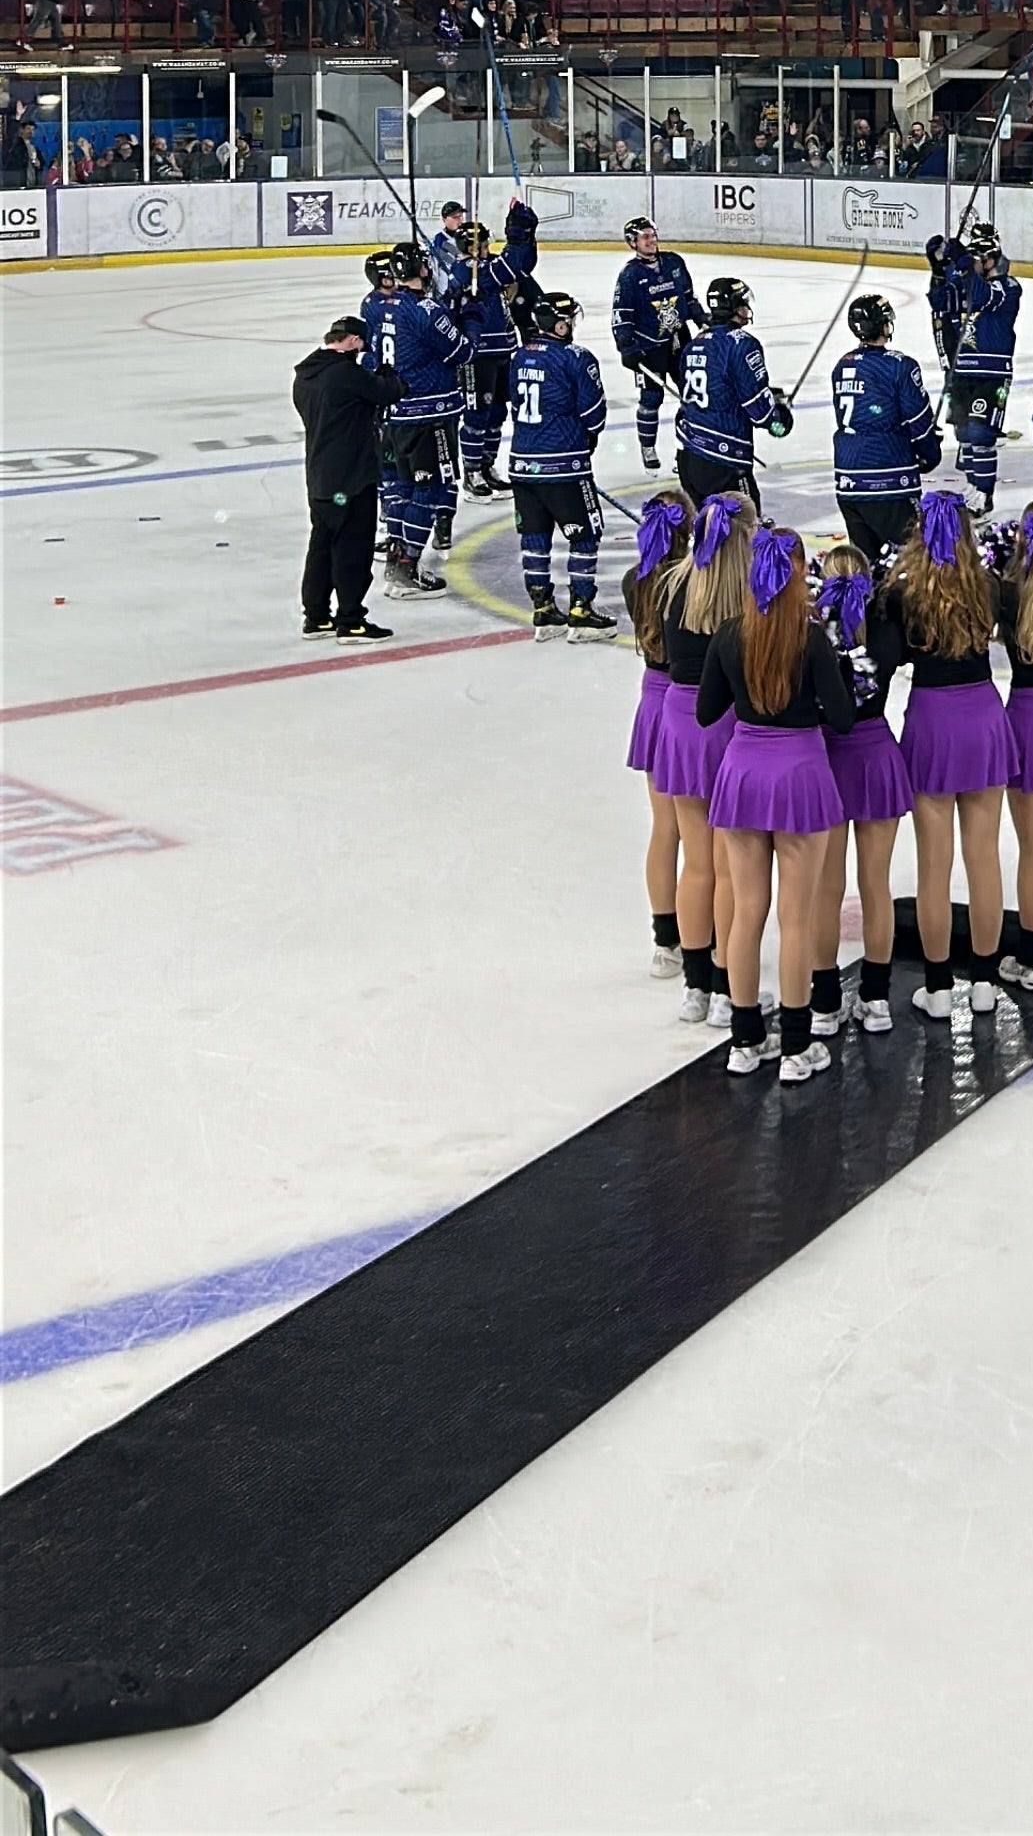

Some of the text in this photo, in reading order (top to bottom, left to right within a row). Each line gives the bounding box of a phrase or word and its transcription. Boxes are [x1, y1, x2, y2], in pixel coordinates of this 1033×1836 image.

[714, 184, 756, 210] IBC
[715, 213, 756, 226] TIPPERS
[517, 382, 543, 424] 21
[839, 395, 856, 434] 7
